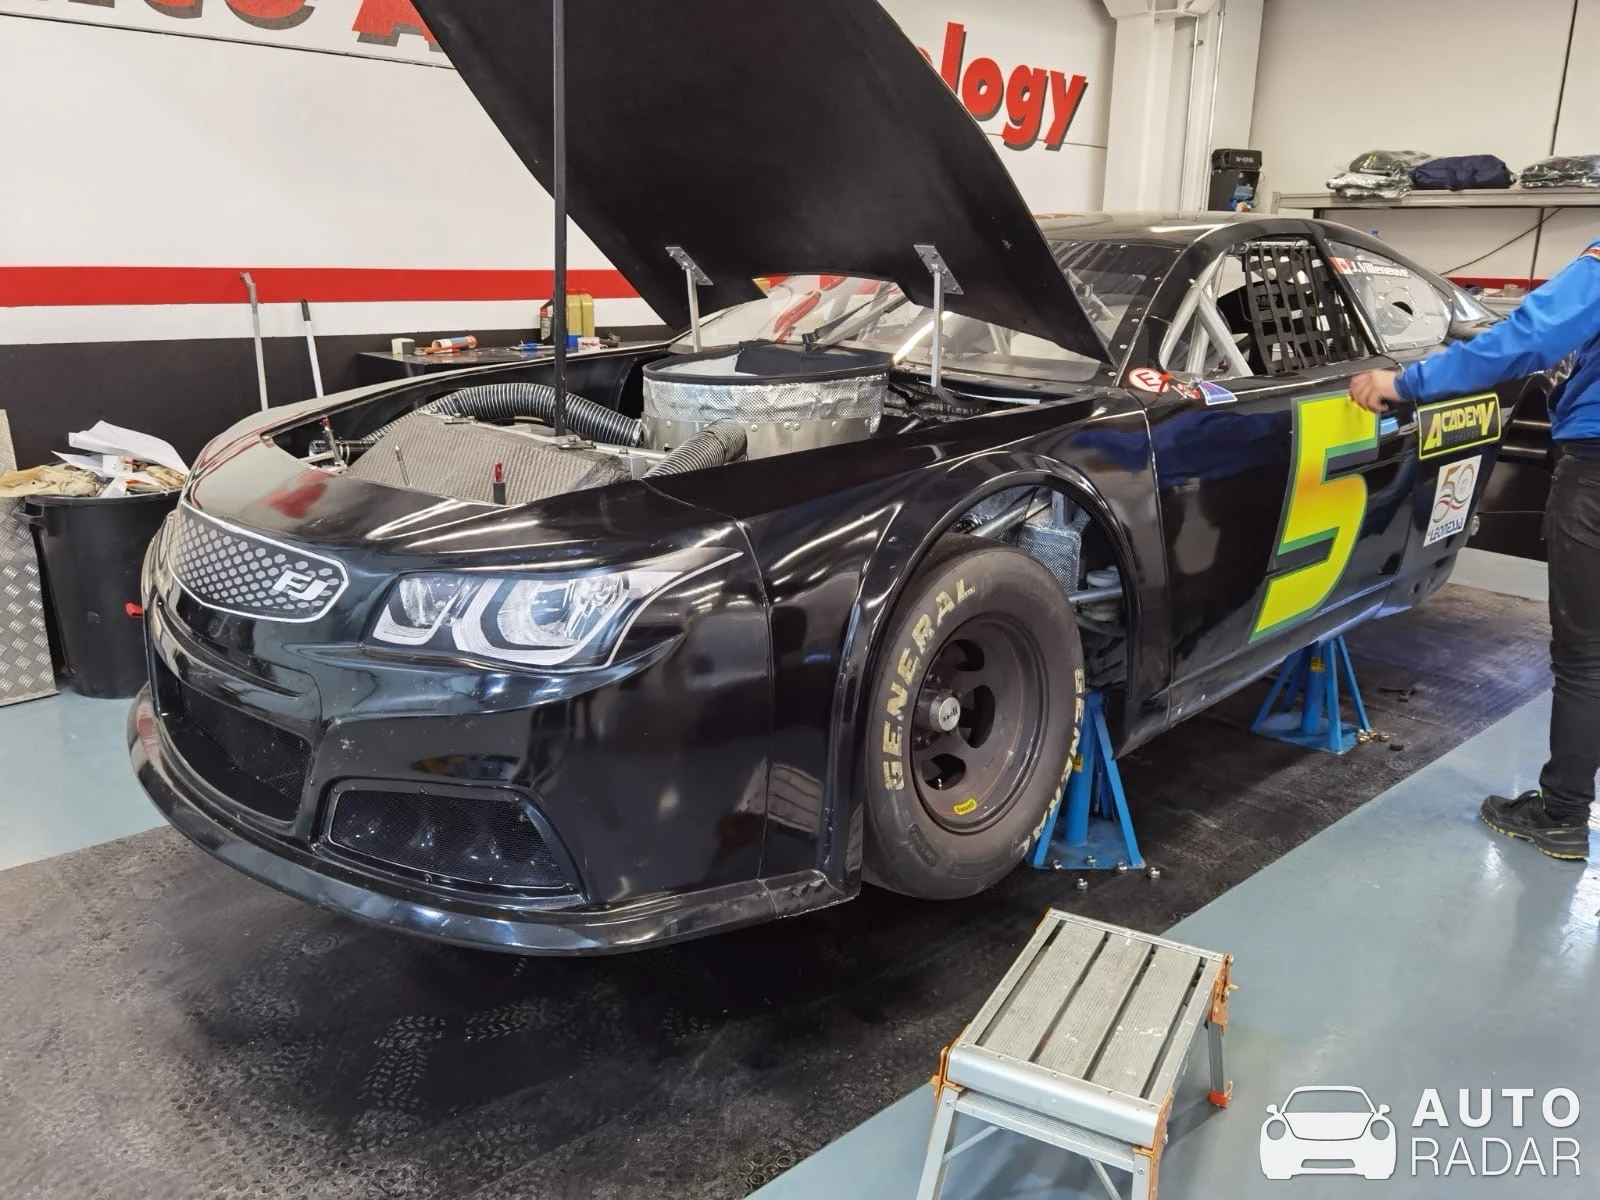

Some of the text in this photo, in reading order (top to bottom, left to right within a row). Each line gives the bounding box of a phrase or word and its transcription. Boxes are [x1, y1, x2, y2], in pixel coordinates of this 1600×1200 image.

[917, 22, 1088, 150] logy
[1423, 401, 1496, 451] ACADEMY
[1251, 392, 1379, 642] 5
[1432, 463, 1475, 523] 50
[272, 569, 329, 601] FJ
[881, 578, 976, 789] GENERAL
